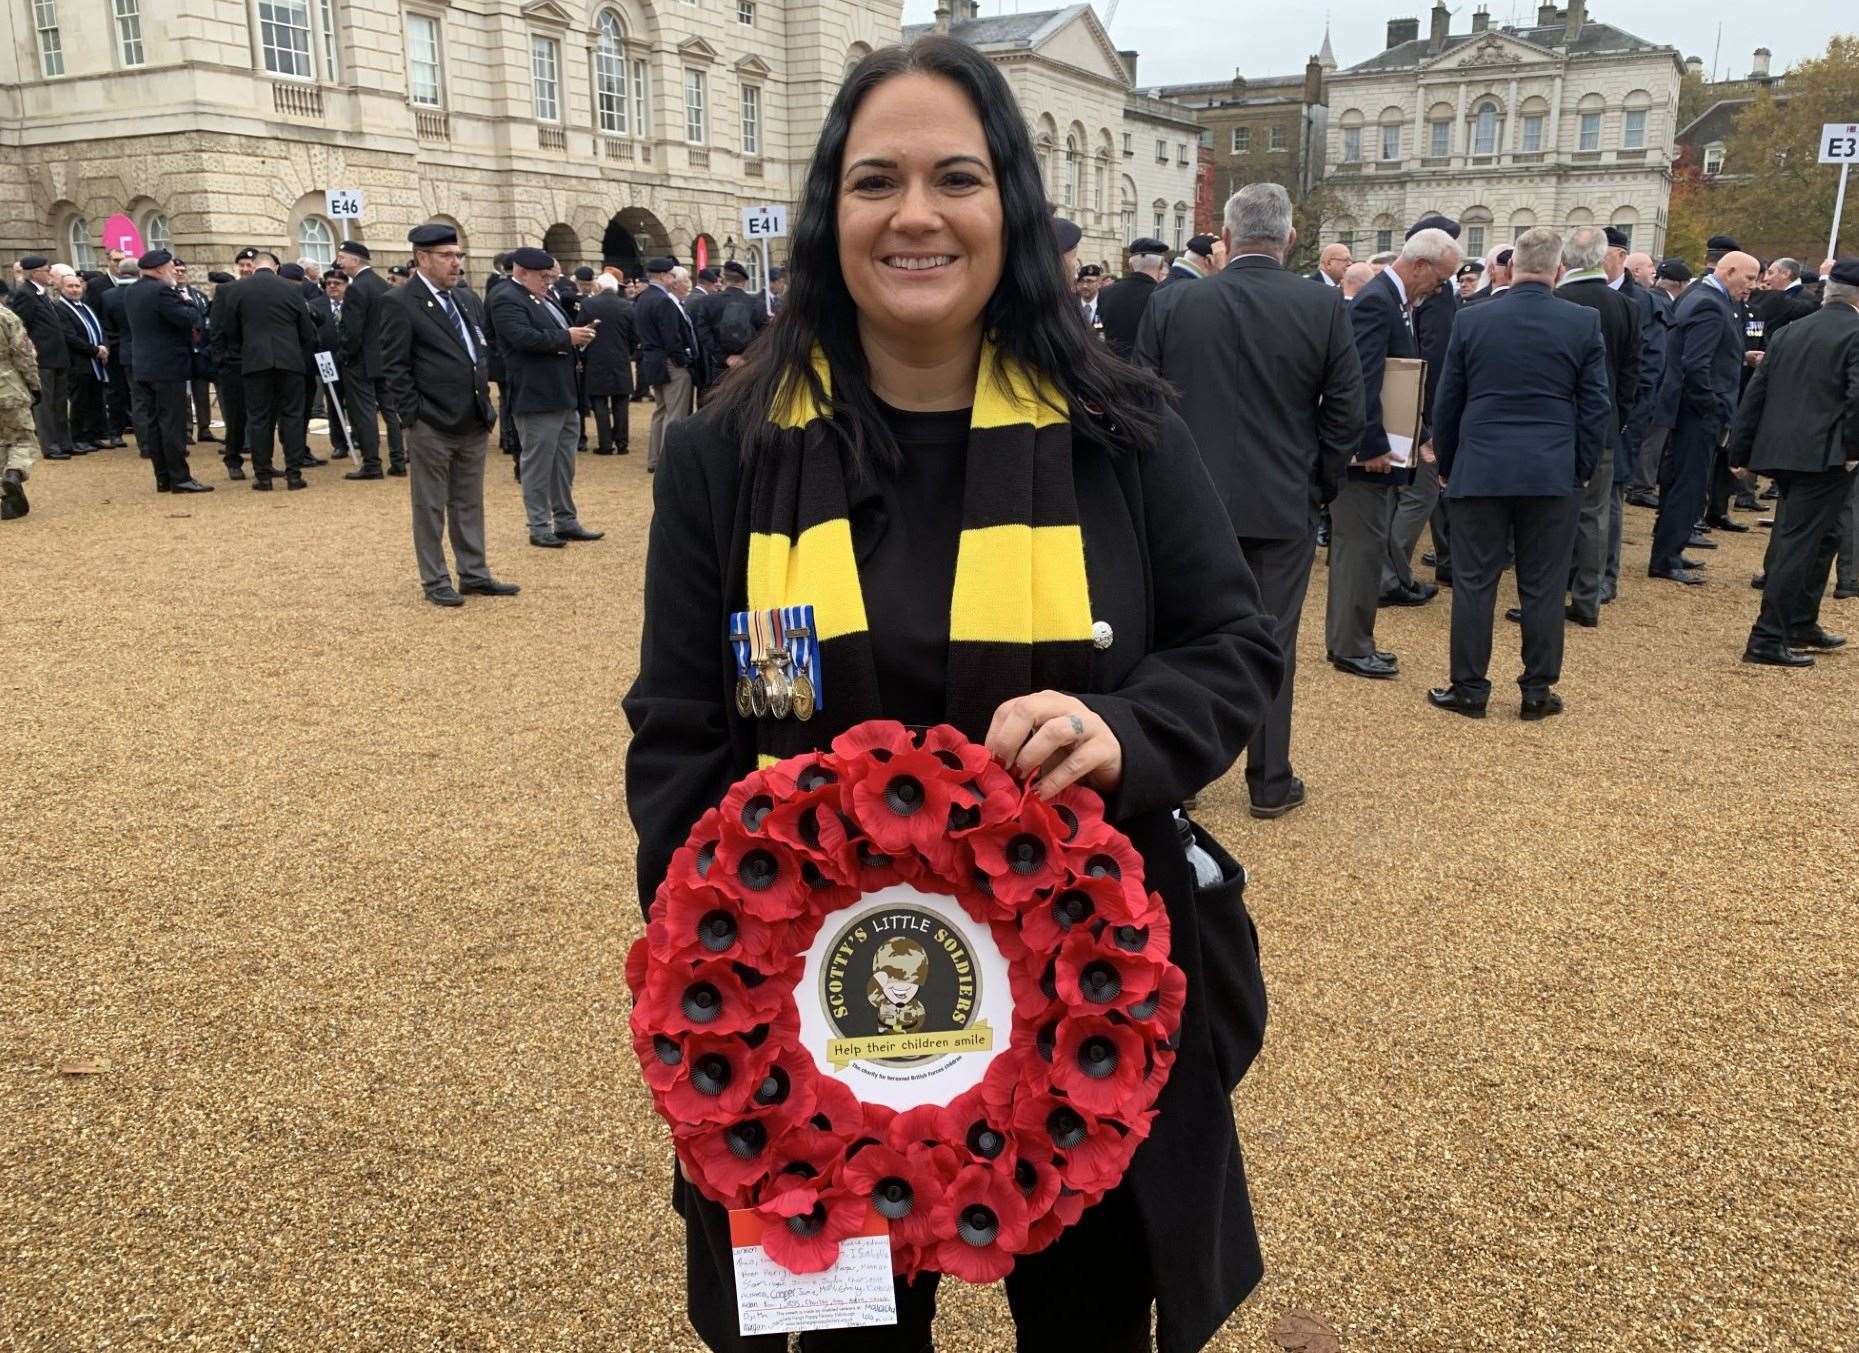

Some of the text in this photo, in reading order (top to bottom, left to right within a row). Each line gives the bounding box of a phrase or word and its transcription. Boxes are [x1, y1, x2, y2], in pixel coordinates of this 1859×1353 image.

[332, 200, 358, 214] E46
[748, 216, 778, 234] E41
[320, 362, 334, 378] E45
[829, 915, 973, 1025] SCOTTY'S LITTLE SOLDIERS
[834, 1034, 985, 1057] Help their children smile
[862, 1068, 878, 1079] charity
[910, 1073, 928, 1081] British
[928, 1068, 944, 1077] Forces
[944, 1056, 962, 1070] children
